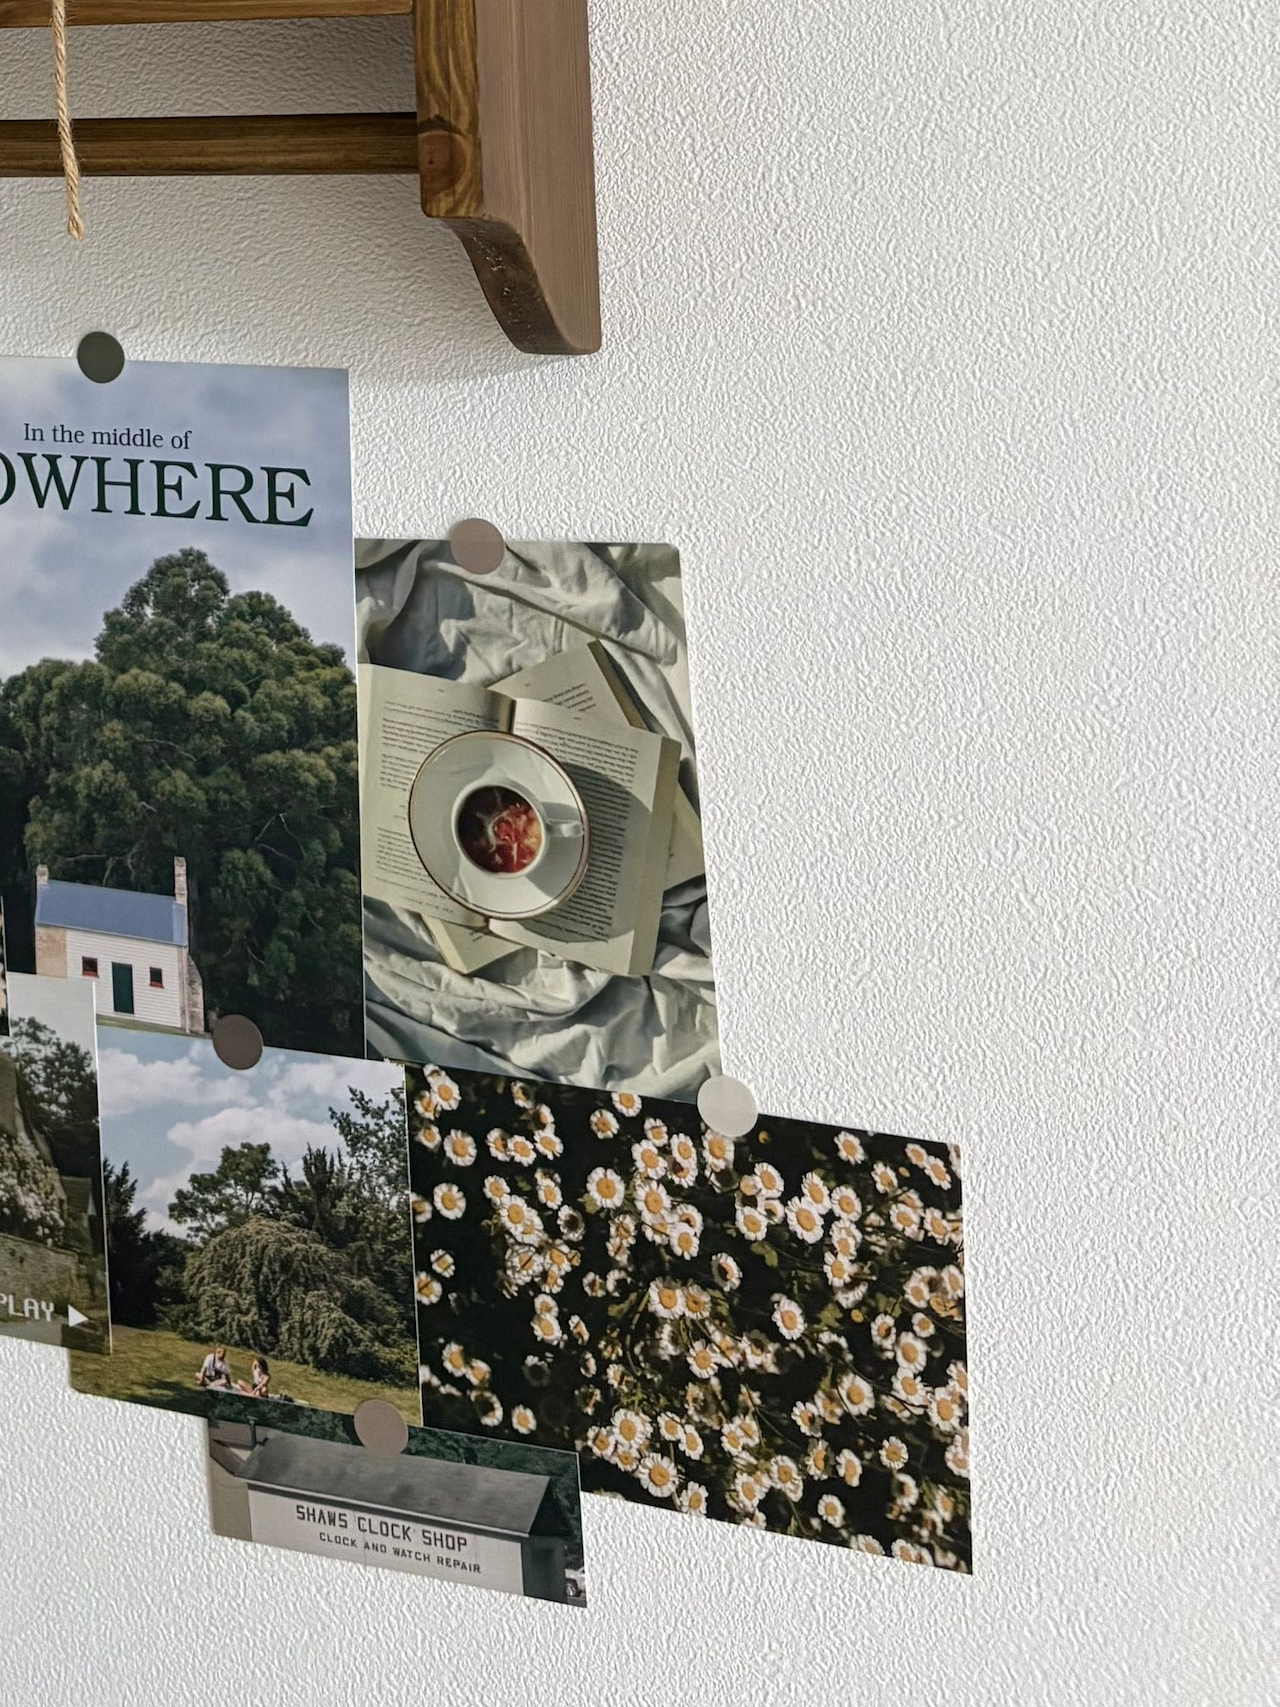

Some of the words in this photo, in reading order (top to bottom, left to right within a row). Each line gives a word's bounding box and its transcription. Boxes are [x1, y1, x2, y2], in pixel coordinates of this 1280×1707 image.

[23, 423, 45, 442] In
[51, 424, 85, 445] the
[91, 428, 164, 448] middle
[170, 430, 193, 450] of
[296, 1504, 348, 1529] SHAWS
[357, 1516, 412, 1542] CLOCK
[422, 1529, 467, 1553] SHOP
[319, 1532, 358, 1548] CLOCK
[363, 1542, 387, 1554] AND
[392, 1547, 431, 1563] WATCH
[437, 1556, 481, 1574] REPAIR
